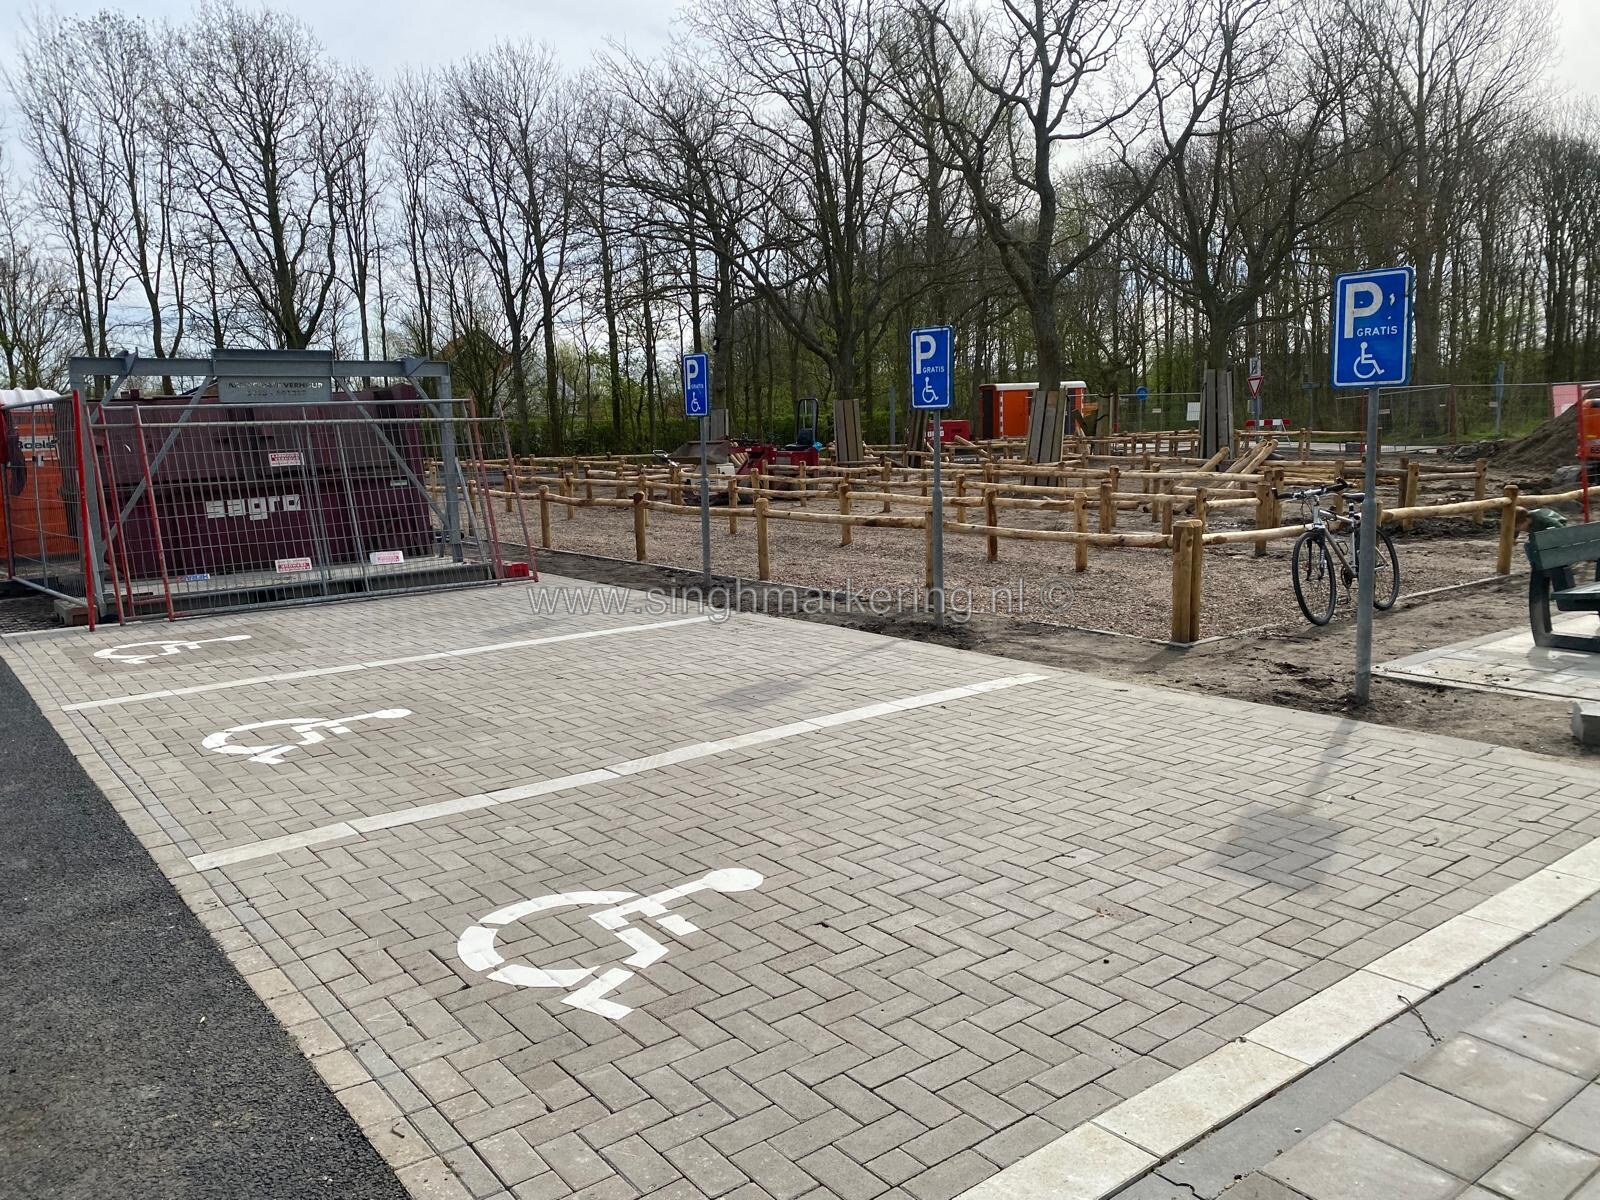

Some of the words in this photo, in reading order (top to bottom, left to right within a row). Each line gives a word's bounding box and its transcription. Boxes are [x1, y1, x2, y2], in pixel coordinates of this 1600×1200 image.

[1344, 281, 1383, 339] P
[1356, 325, 1398, 337] GRATIS
[915, 334, 937, 375] P
[922, 366, 945, 374] GRATIS
[686, 359, 699, 390] P
